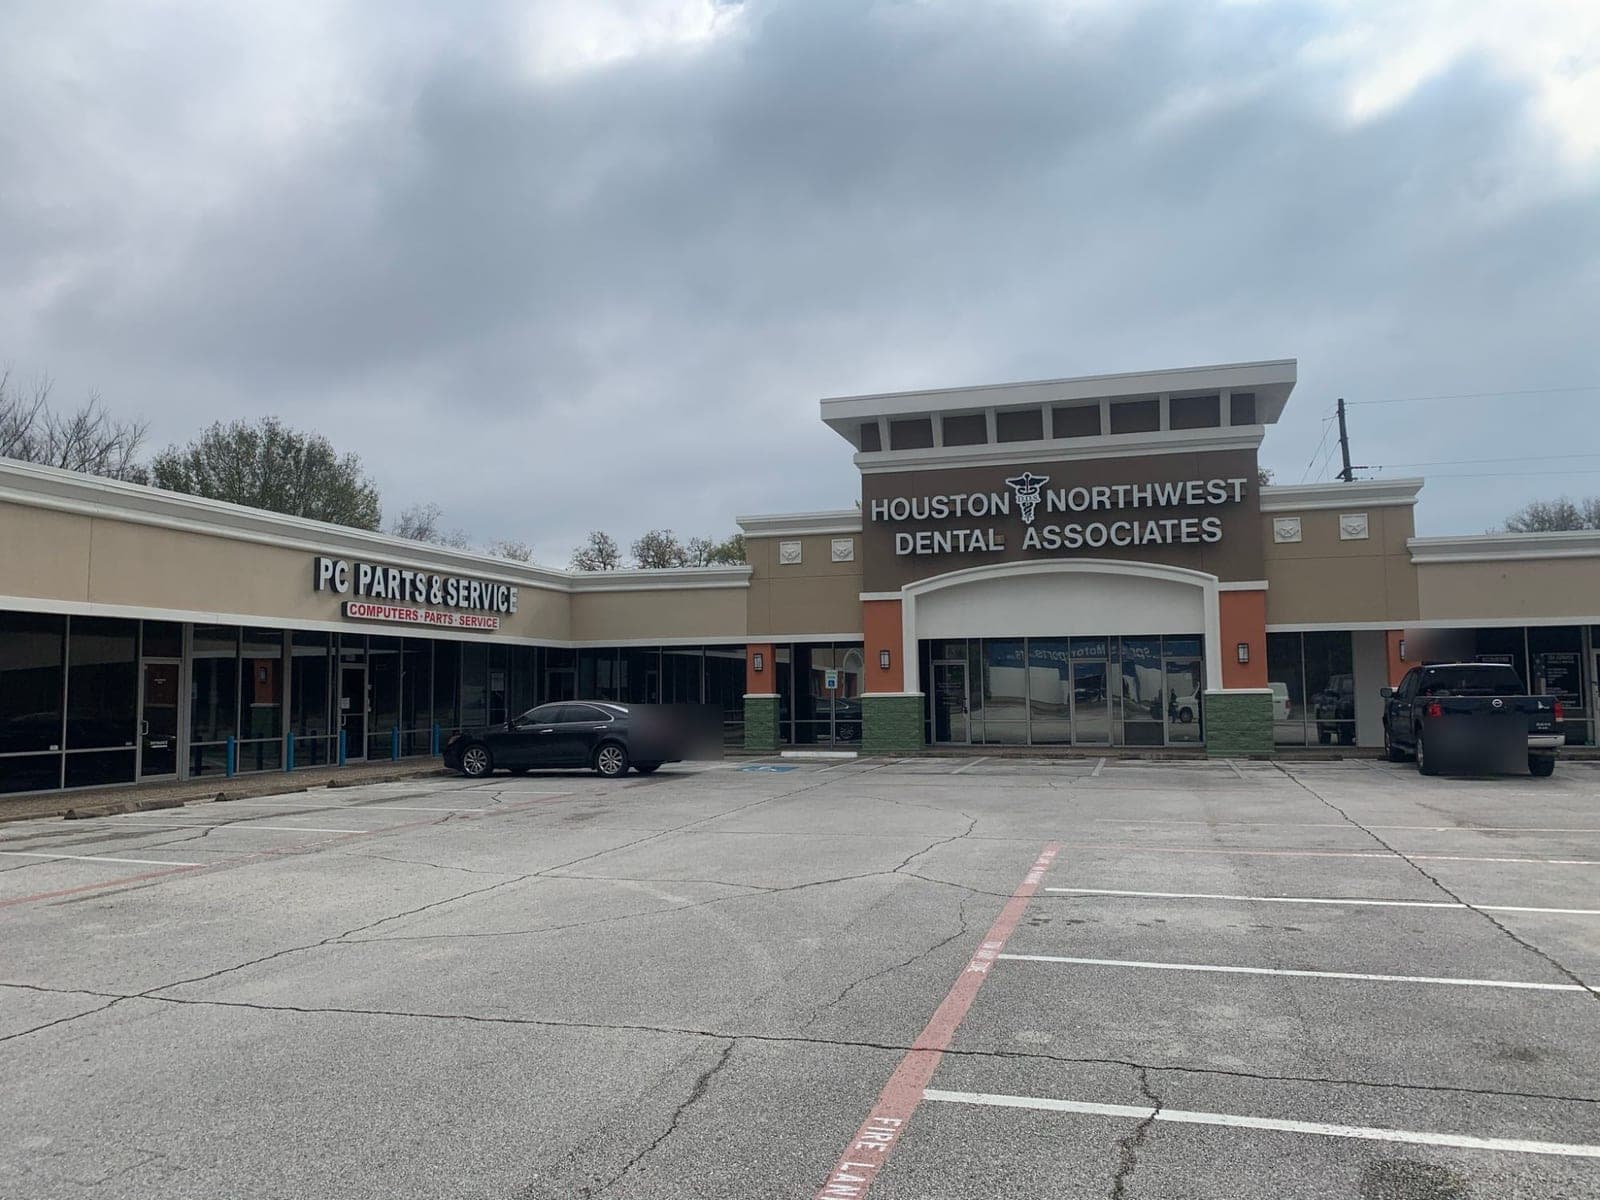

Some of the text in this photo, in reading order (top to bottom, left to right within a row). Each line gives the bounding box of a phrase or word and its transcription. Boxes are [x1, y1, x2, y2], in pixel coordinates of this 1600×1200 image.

[871, 478, 1248, 522] HOUSTON NORTHWEST
[895, 516, 1223, 556] DENTAL ASSOCIATES
[316, 557, 519, 614] PC PARTS & SERVICE
[349, 603, 498, 629] COMPUTERS PARTS SERVICE
[820, 1117, 903, 1200] FIRE LAN
